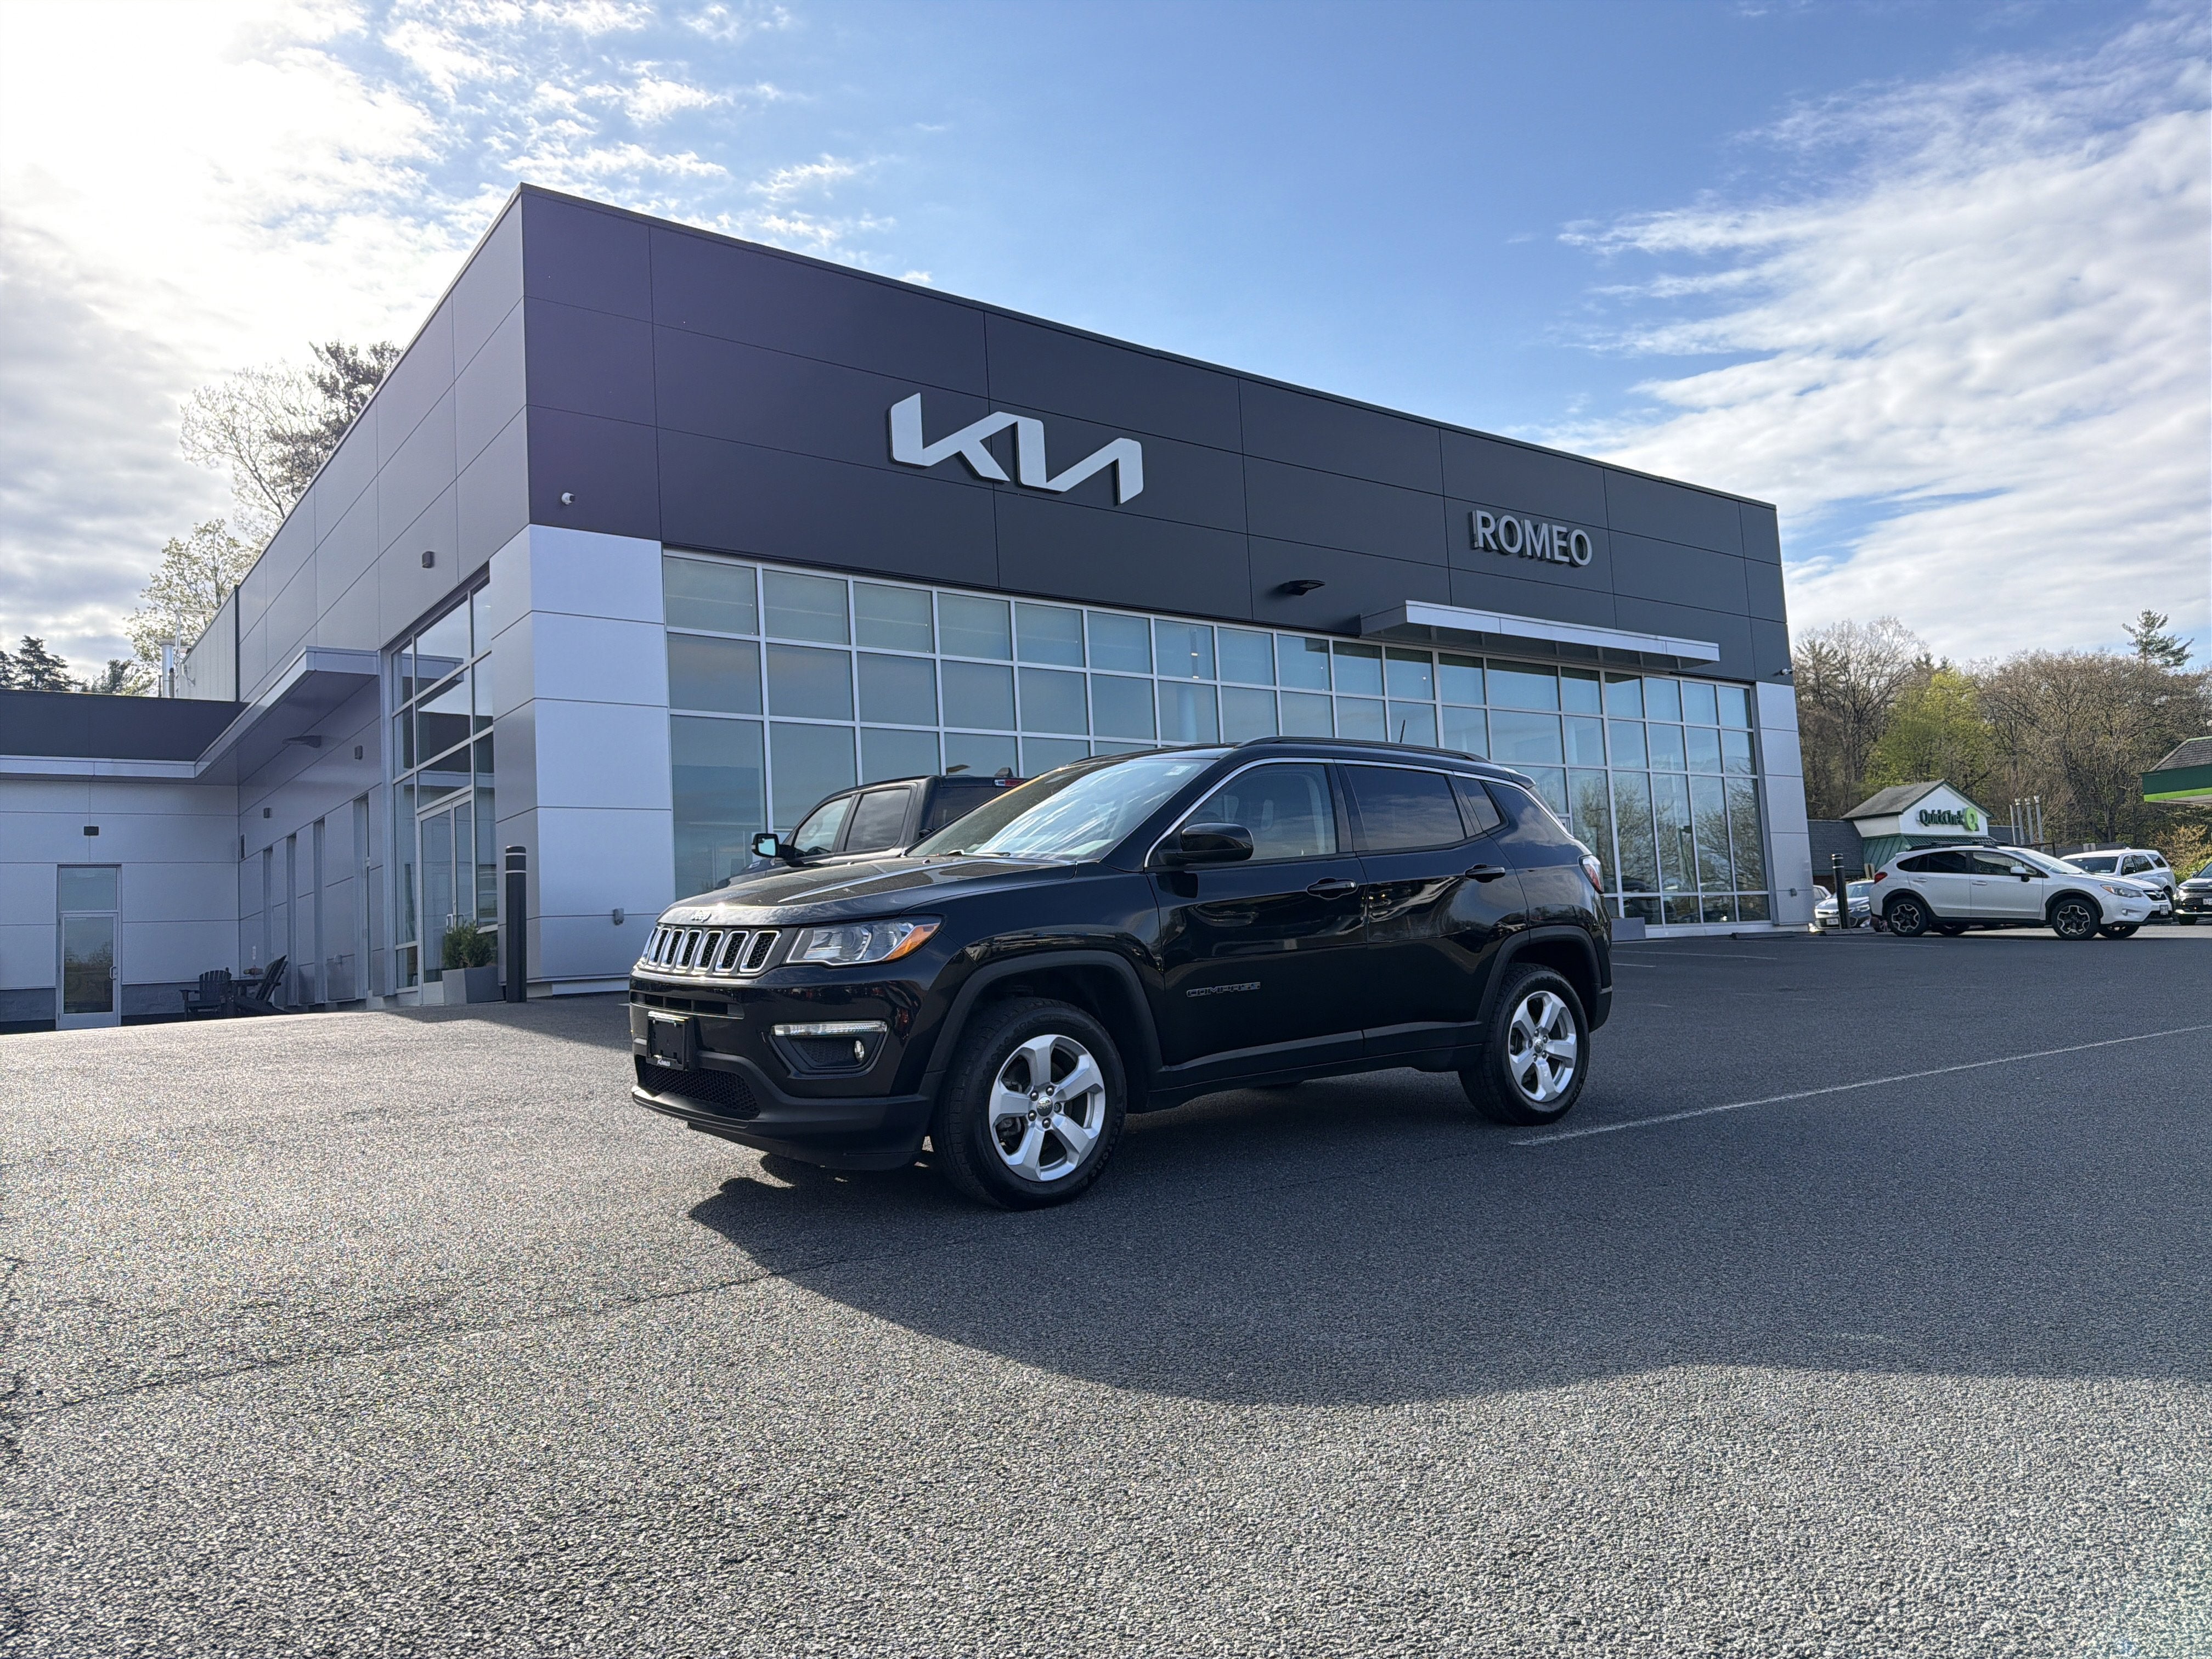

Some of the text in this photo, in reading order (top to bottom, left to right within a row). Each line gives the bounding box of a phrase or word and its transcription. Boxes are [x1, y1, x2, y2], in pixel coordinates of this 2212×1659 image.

[889, 392, 1144, 505] KIA
[1471, 510, 1593, 567] ROMEO
[1186, 981, 1261, 998] COMPASS
